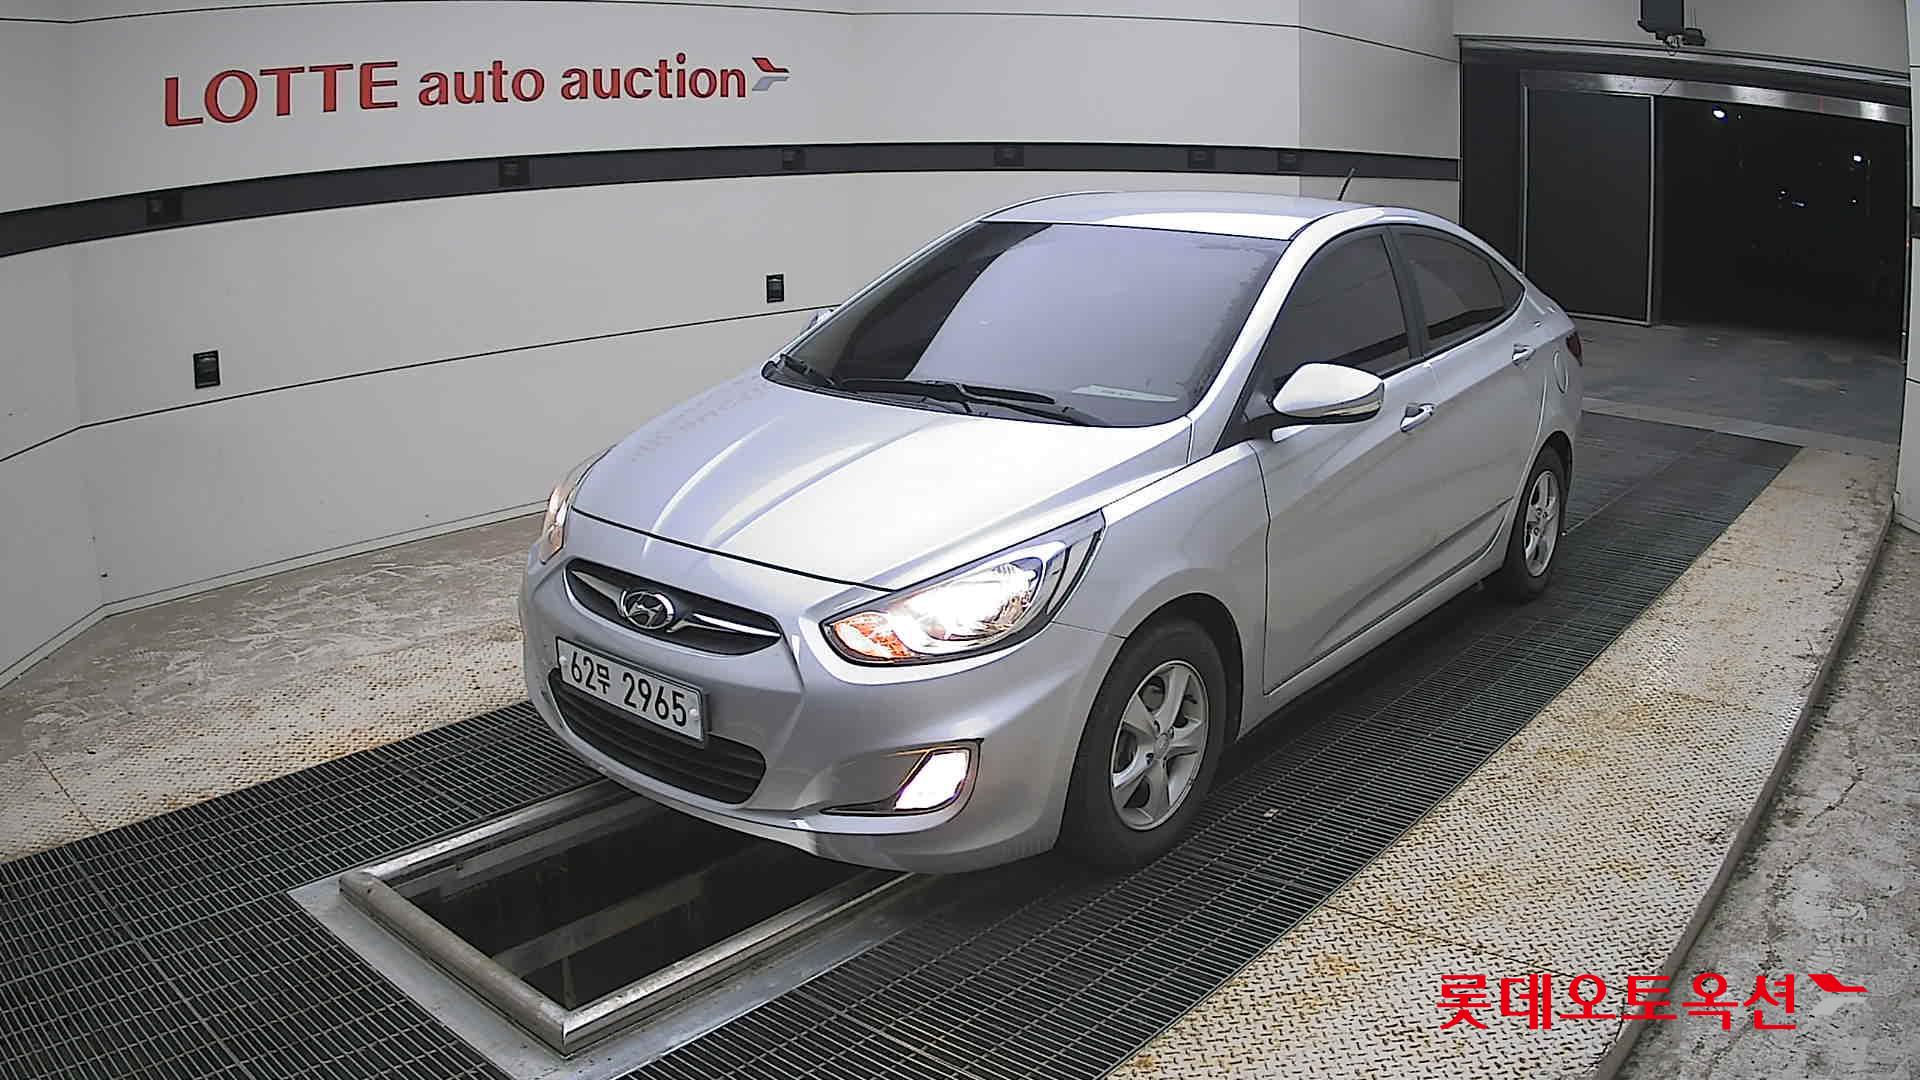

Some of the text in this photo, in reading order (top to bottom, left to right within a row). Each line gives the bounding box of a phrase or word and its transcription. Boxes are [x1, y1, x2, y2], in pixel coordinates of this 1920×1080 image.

[164, 52, 747, 127] LOTTE auto auction
[571, 651, 687, 727] 62무 2965
